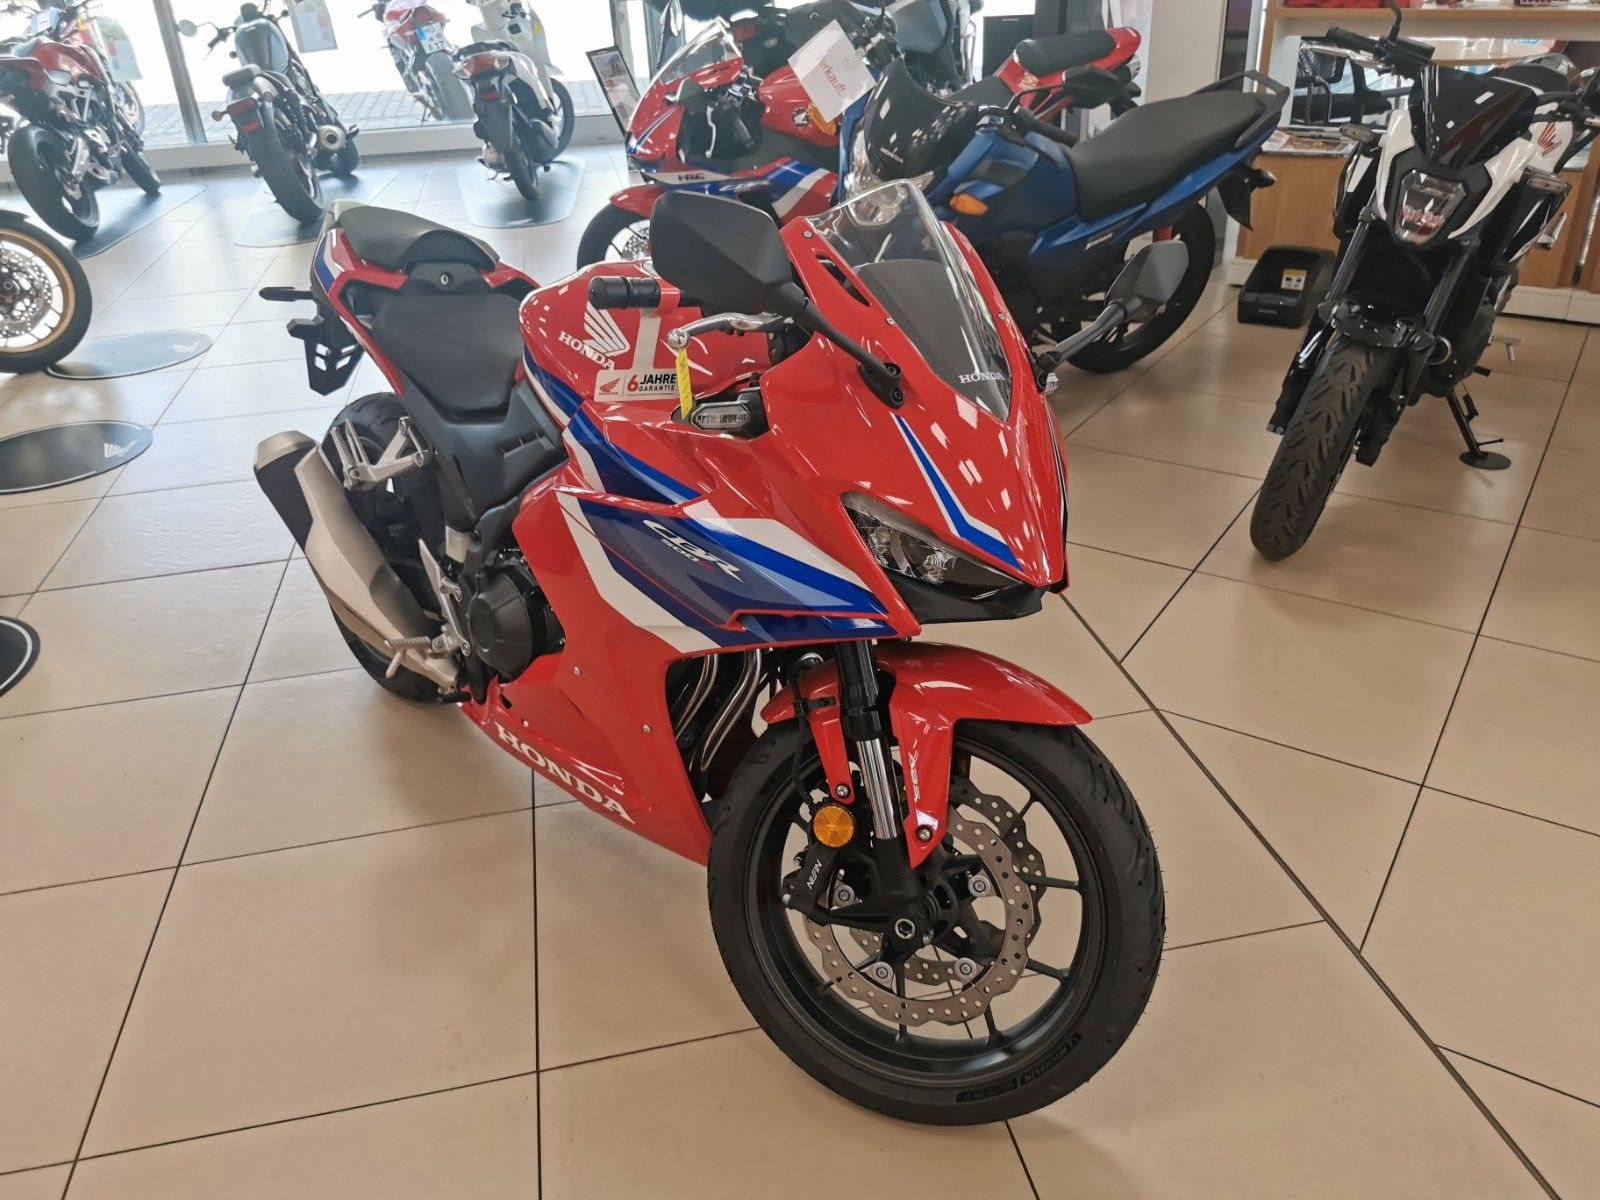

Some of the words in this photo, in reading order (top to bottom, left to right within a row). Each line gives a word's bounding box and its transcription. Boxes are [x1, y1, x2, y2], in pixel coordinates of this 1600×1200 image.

[880, 147, 904, 164] HONDA
[558, 331, 615, 371] HONDA
[627, 375, 639, 392] 6
[640, 373, 677, 385] JAHRE
[958, 371, 1006, 384] HONDA
[639, 384, 675, 393] GARANTIE
[642, 520, 744, 583] CBR
[494, 721, 635, 824] HONDA
